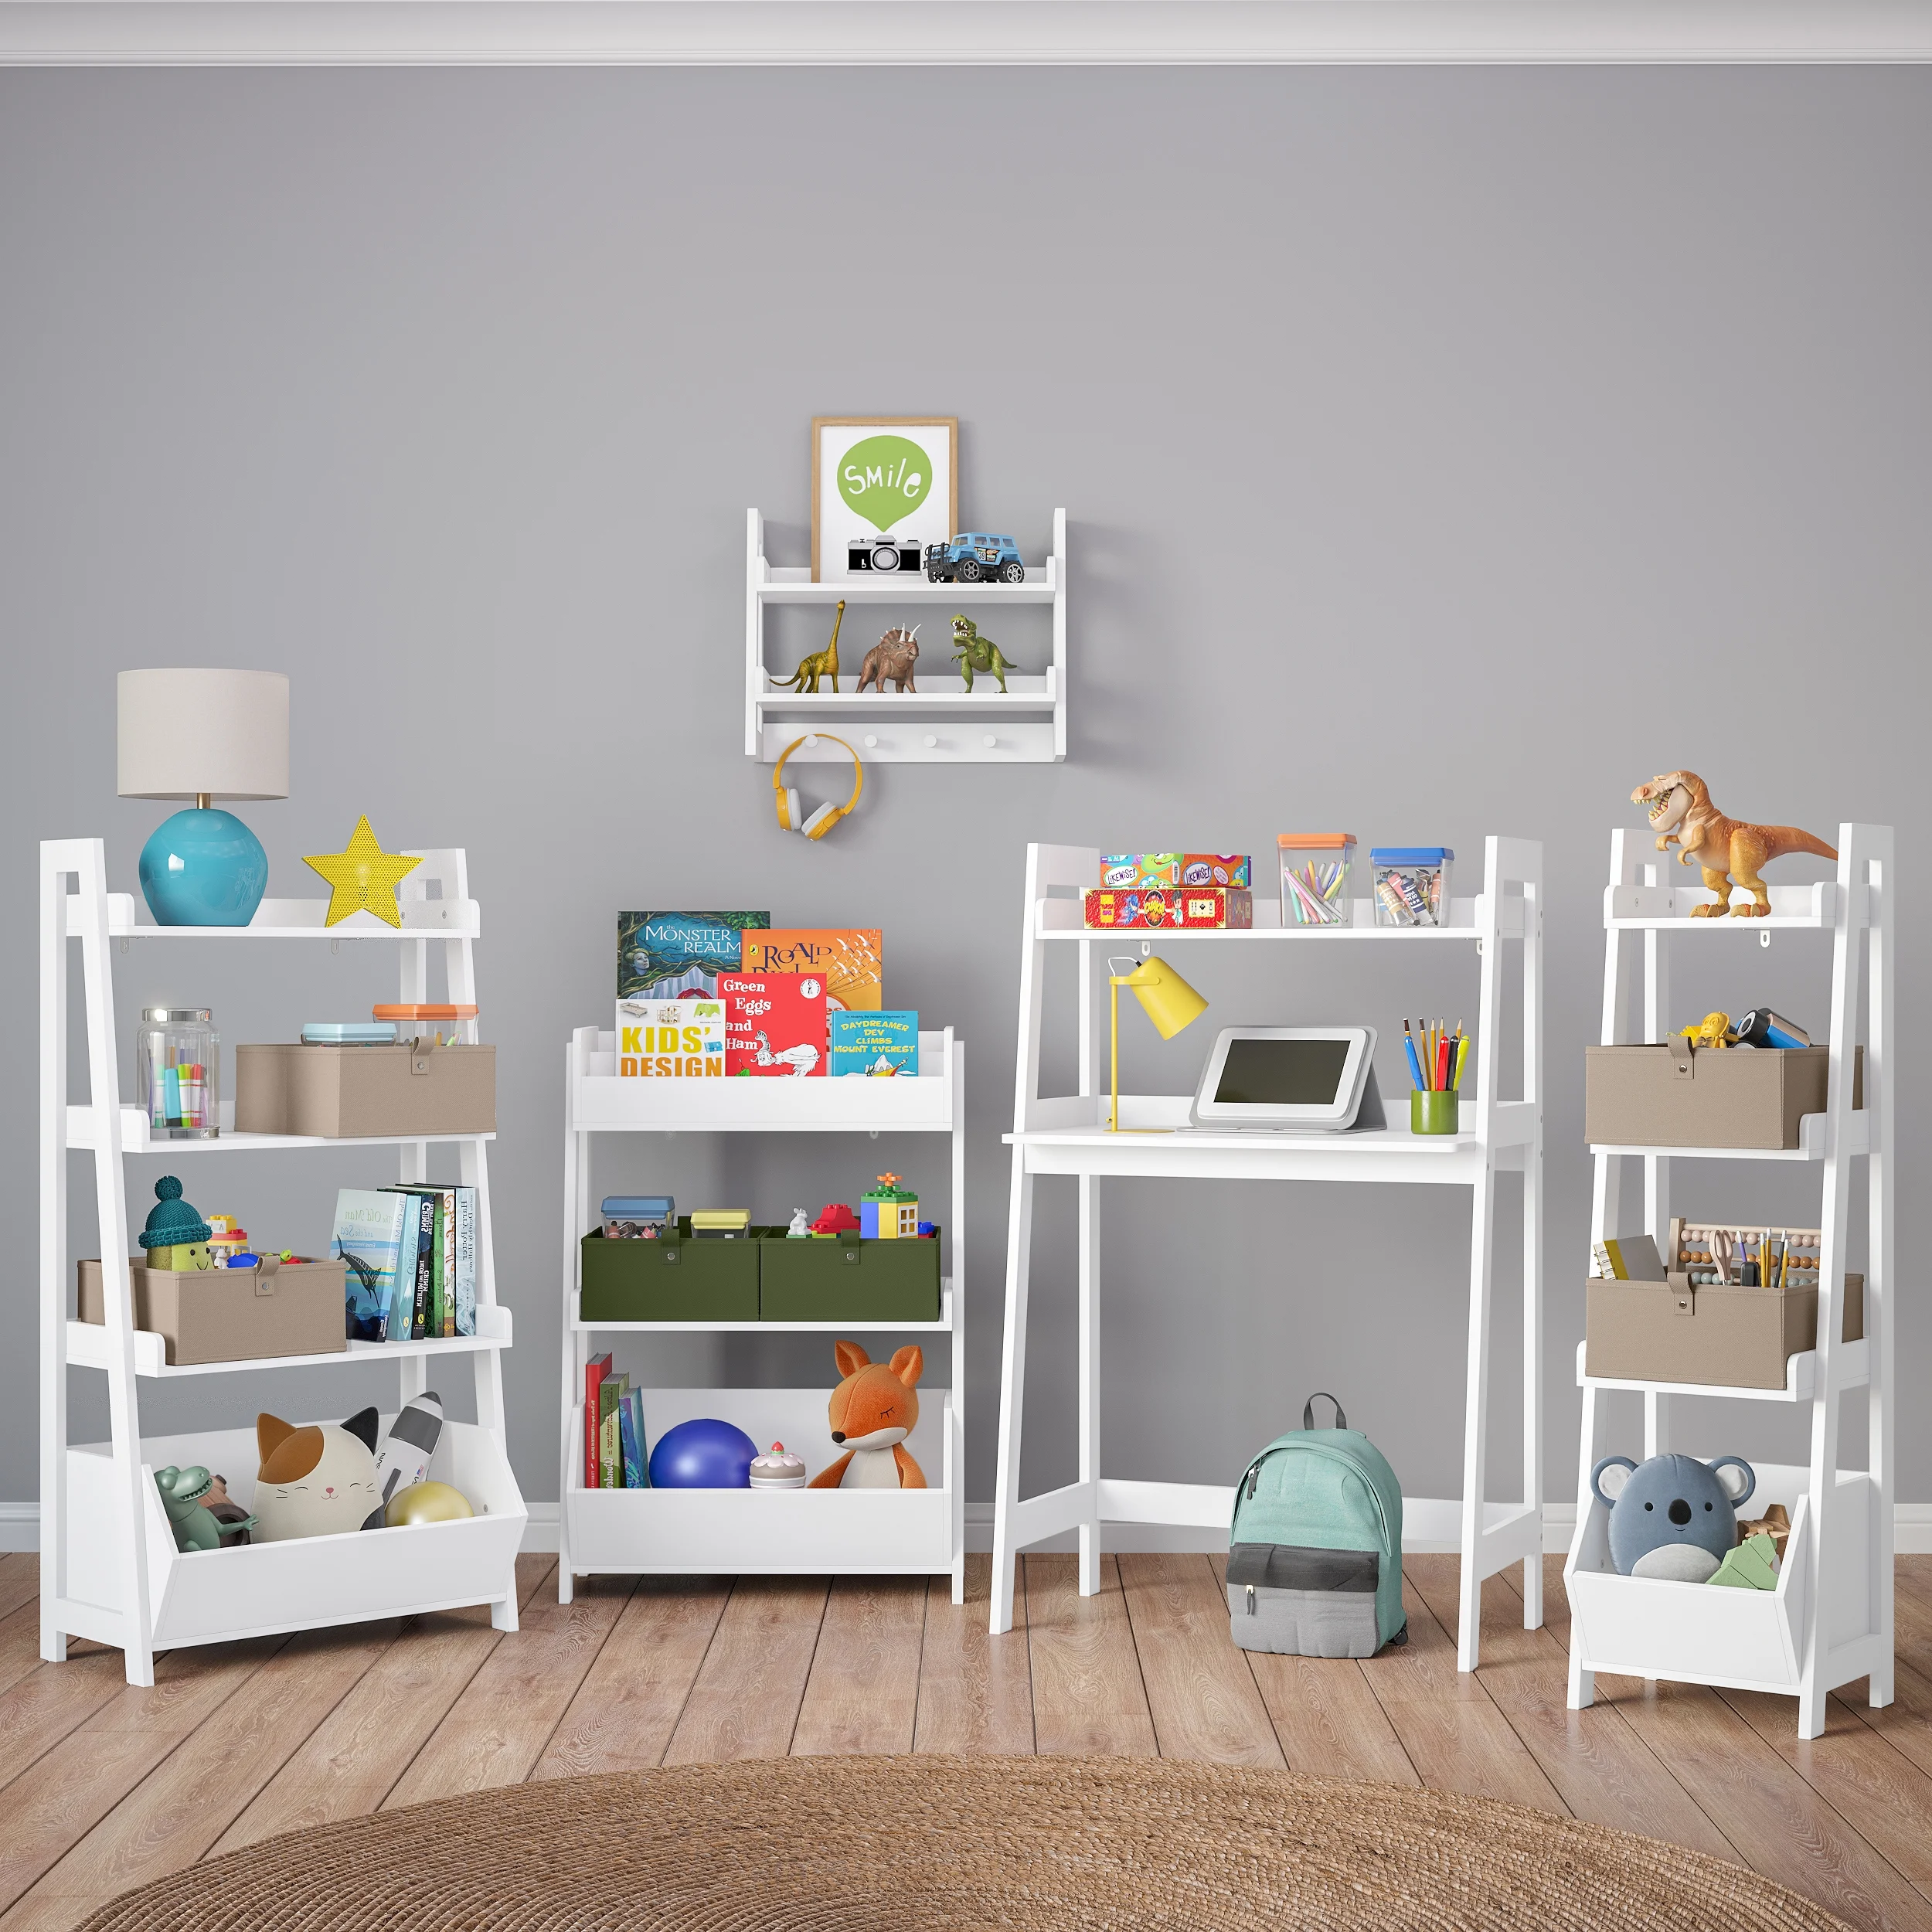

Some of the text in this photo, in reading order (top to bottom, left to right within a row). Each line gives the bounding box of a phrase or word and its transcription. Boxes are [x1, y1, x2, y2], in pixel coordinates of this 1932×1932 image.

[645, 925, 732, 941] MONSTER
[684, 941, 741, 954] REALM
[761, 942, 832, 970] ROALD
[723, 978, 766, 993] Green
[734, 997, 772, 1016] Eggs
[726, 1019, 753, 1032] and
[840, 1020, 910, 1032] DAYDREAMER
[726, 1037, 758, 1050] Ham
[834, 1045, 916, 1053] MOUNT EVEREST
[621, 1056, 723, 1077] DESIGN
